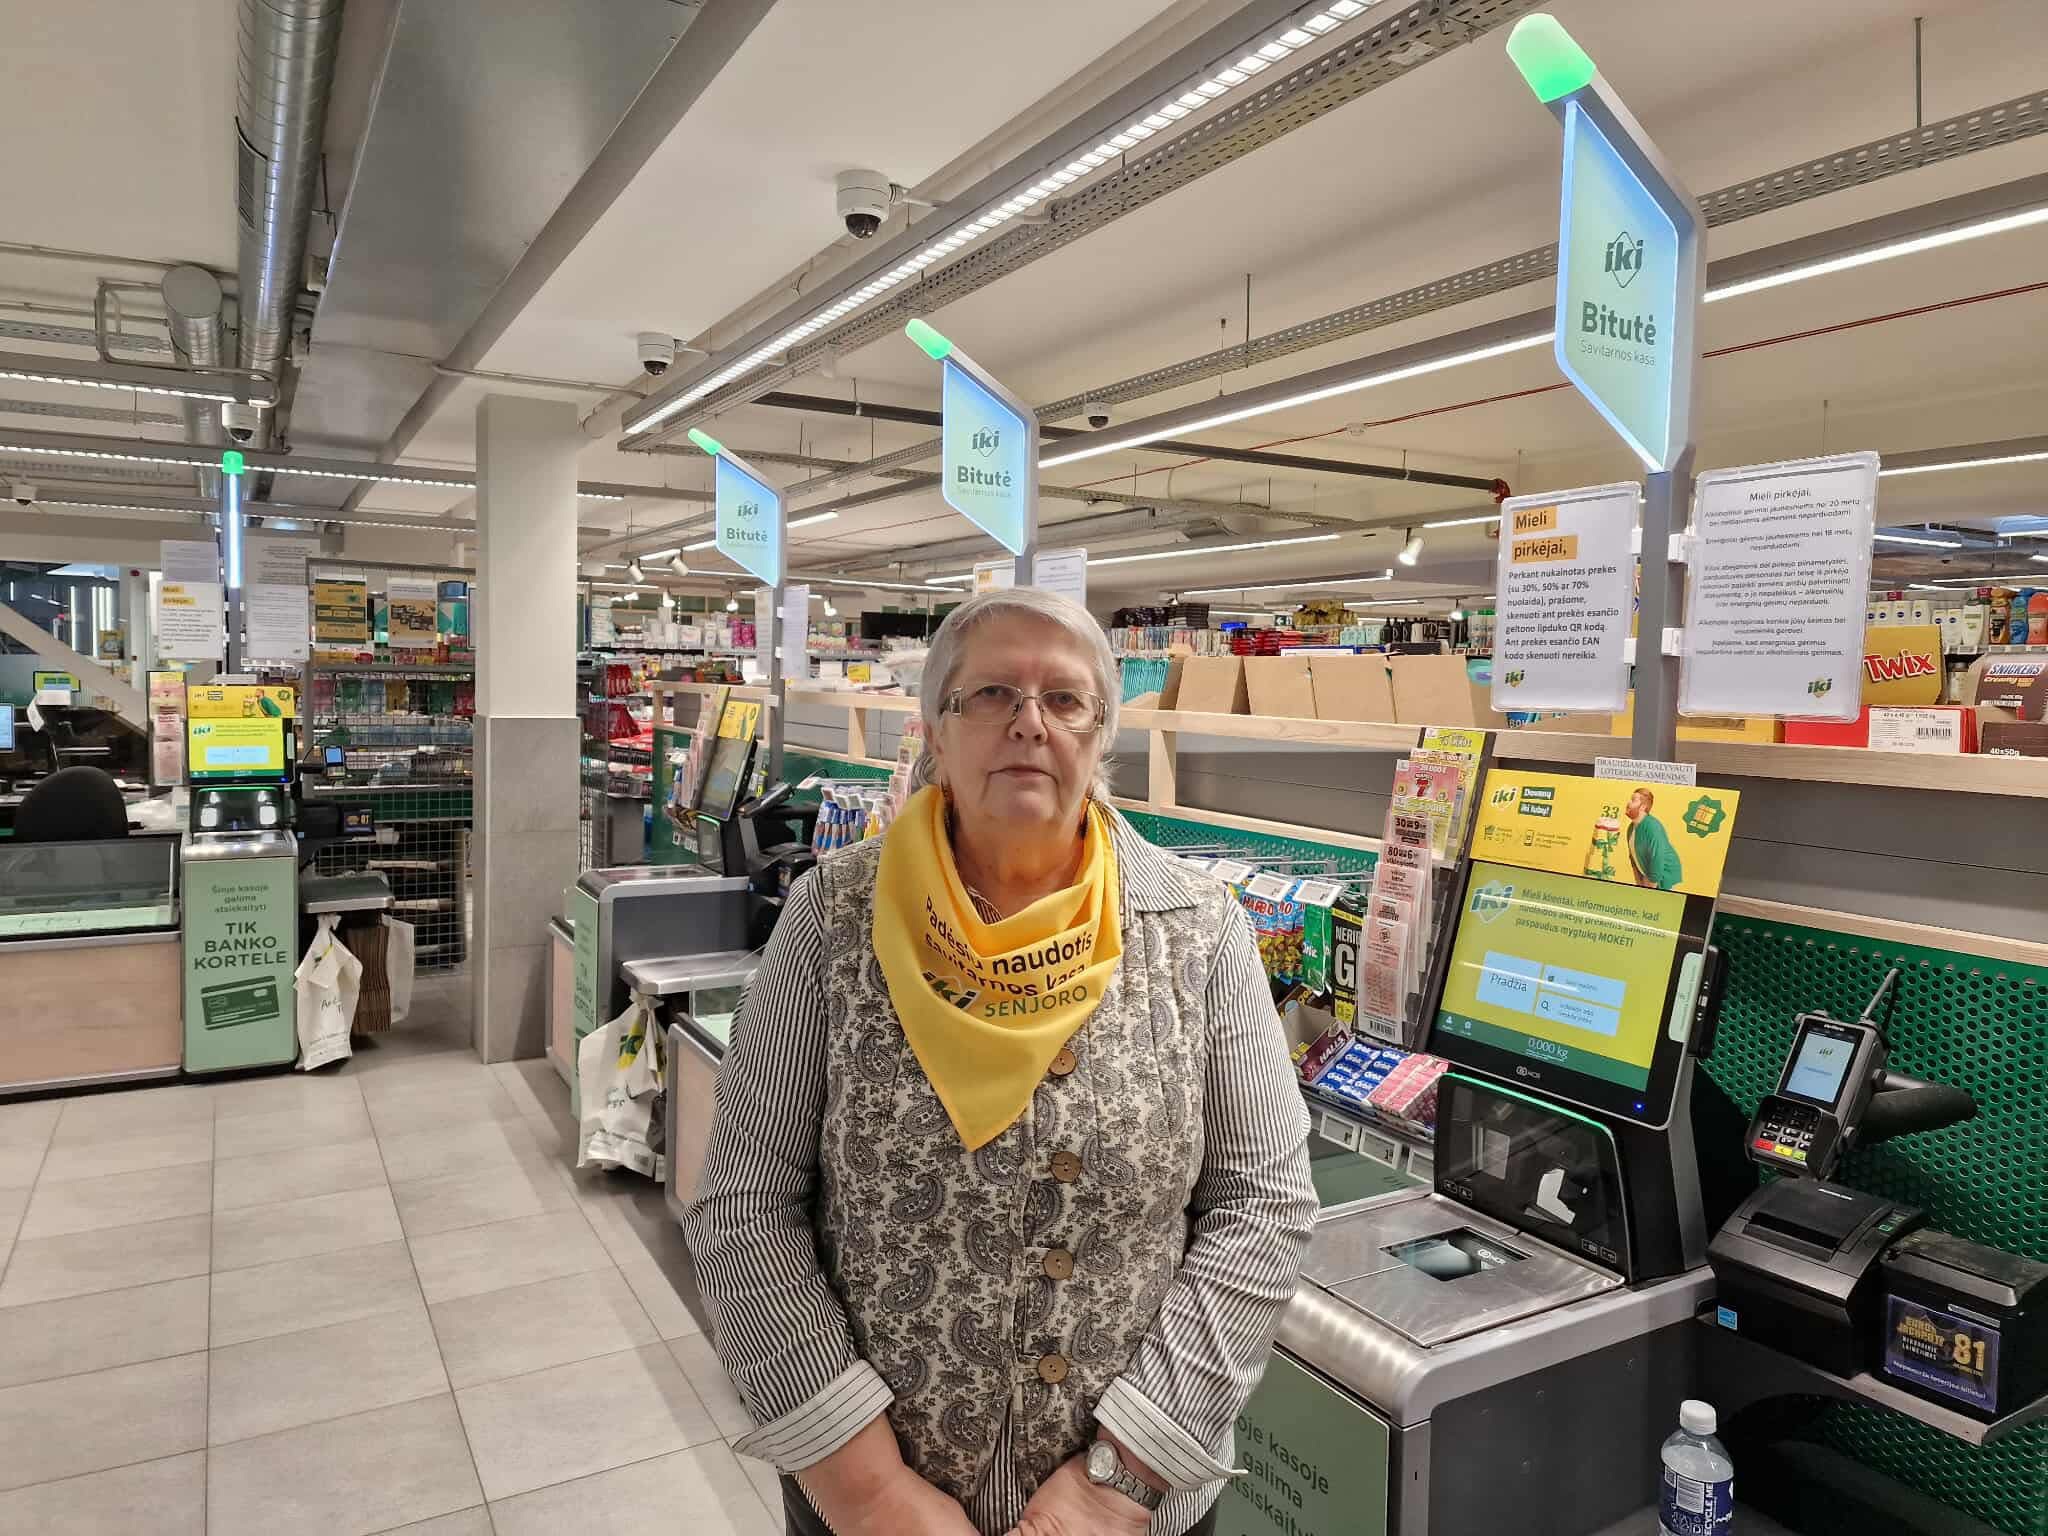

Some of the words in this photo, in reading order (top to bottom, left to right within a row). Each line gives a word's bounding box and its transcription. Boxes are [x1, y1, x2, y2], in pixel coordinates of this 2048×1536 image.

[1604, 239, 1644, 272] iki
[1582, 301, 1657, 345] Bitutė
[972, 430, 1000, 450] iki
[957, 465, 1012, 487] Bitutė
[1749, 491, 1772, 502] Mieli
[737, 503, 759, 517] iki
[1514, 511, 1548, 529] Mieli
[726, 527, 768, 542] Bitutė
[1513, 539, 1568, 560] pirkėjai,
[1509, 571, 1539, 579] Perkant
[1541, 567, 1586, 578] nukainotas
[1542, 582, 1560, 592] 50%
[1571, 580, 1590, 590] 70%
[1542, 609, 1556, 619] ant
[1586, 607, 1620, 617] esančio
[1505, 624, 1536, 635] geltono
[1537, 622, 1568, 634] lipduko
[1569, 622, 1582, 633] QR
[1504, 638, 1520, 646] Ant
[1549, 636, 1580, 646] esančio
[1582, 636, 1600, 646] EAN
[1504, 651, 1525, 660] kodo
[1525, 651, 1561, 660] skenuoti
[1504, 668, 1525, 685] iki
[1808, 678, 1833, 694] iki
[1415, 779, 1430, 798] 7
[1493, 788, 1516, 804] iki
[1601, 805, 1620, 820] 33
[1470, 884, 1513, 914] iki
[1642, 909, 1660, 923] kad
[225, 920, 257, 936] TIK
[204, 935, 278, 953] BANKO
[193, 950, 289, 970] KORTELE
[991, 931, 1093, 976] naudotis
[983, 984, 1089, 1018] SENJORO
[1319, 1036, 1346, 1065] HALLS
[1953, 1333, 1986, 1371] 81
[1269, 1431, 1329, 1494] kasoje
[1242, 1451, 1303, 1509] galima
